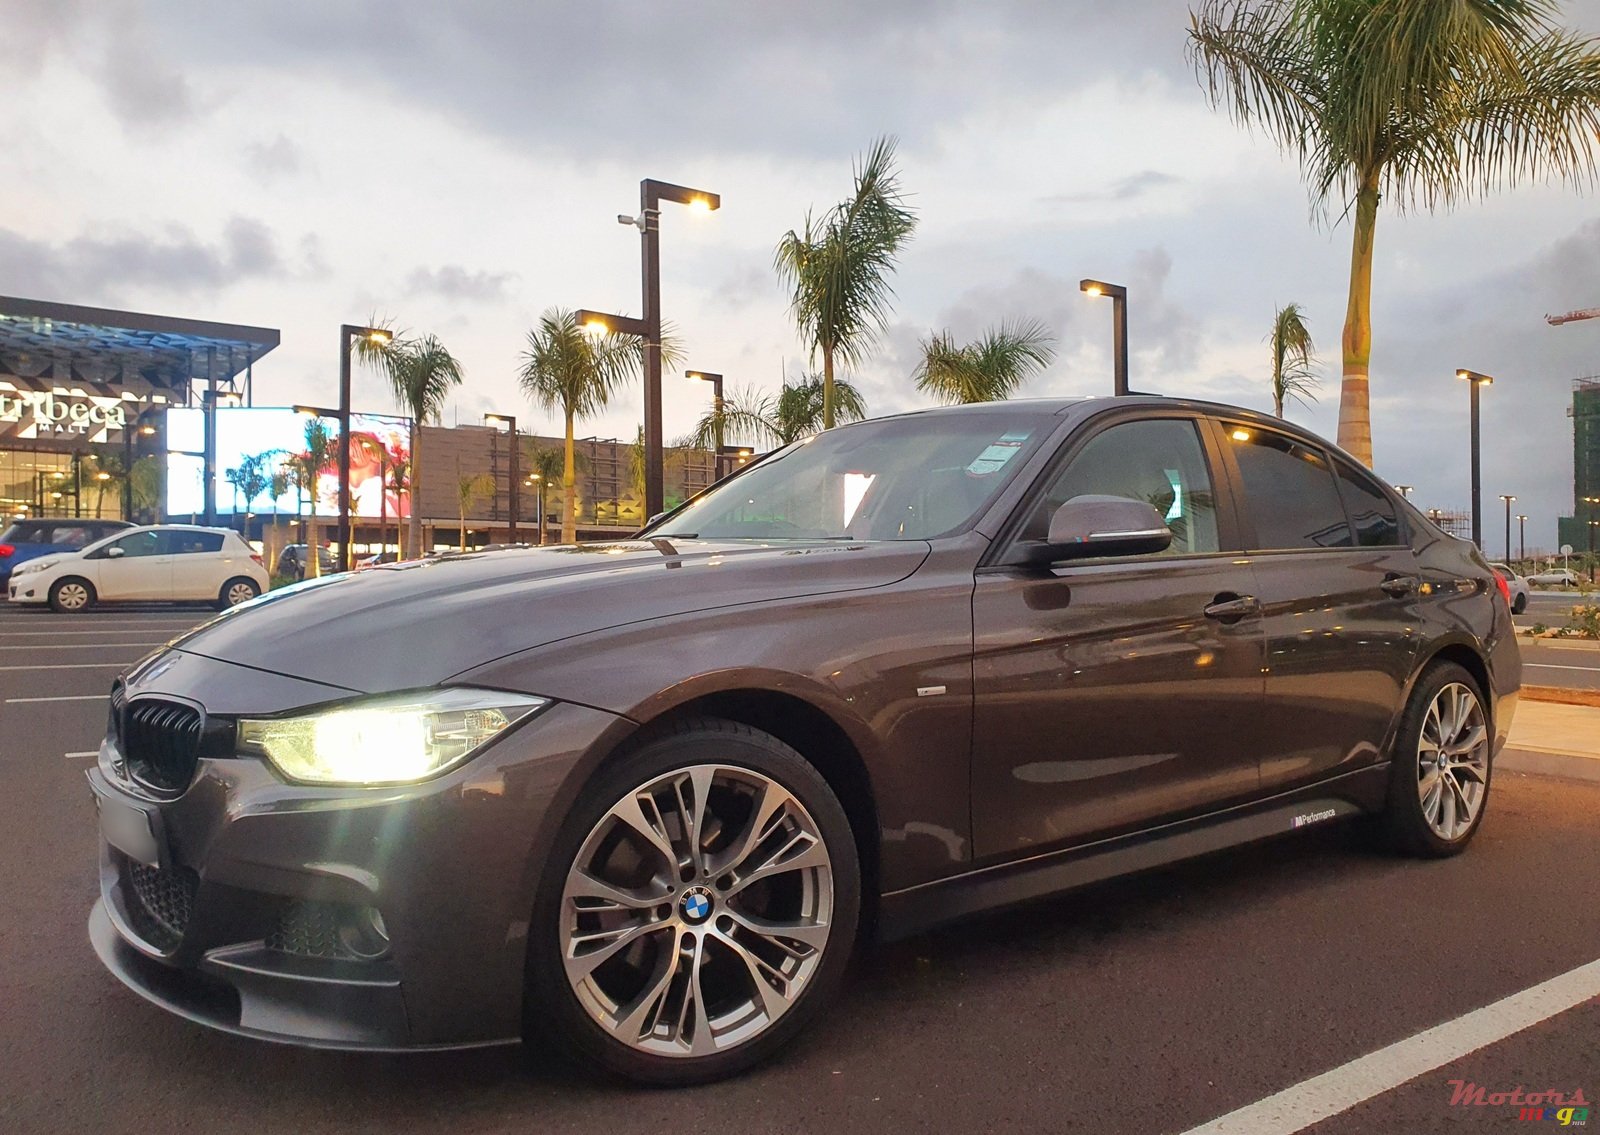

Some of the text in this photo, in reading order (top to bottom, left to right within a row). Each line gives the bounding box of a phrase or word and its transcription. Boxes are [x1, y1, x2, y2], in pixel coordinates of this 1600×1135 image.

[0, 391, 126, 425] tribeca
[39, 423, 87, 434] MALL
[680, 887, 710, 905] BMW
